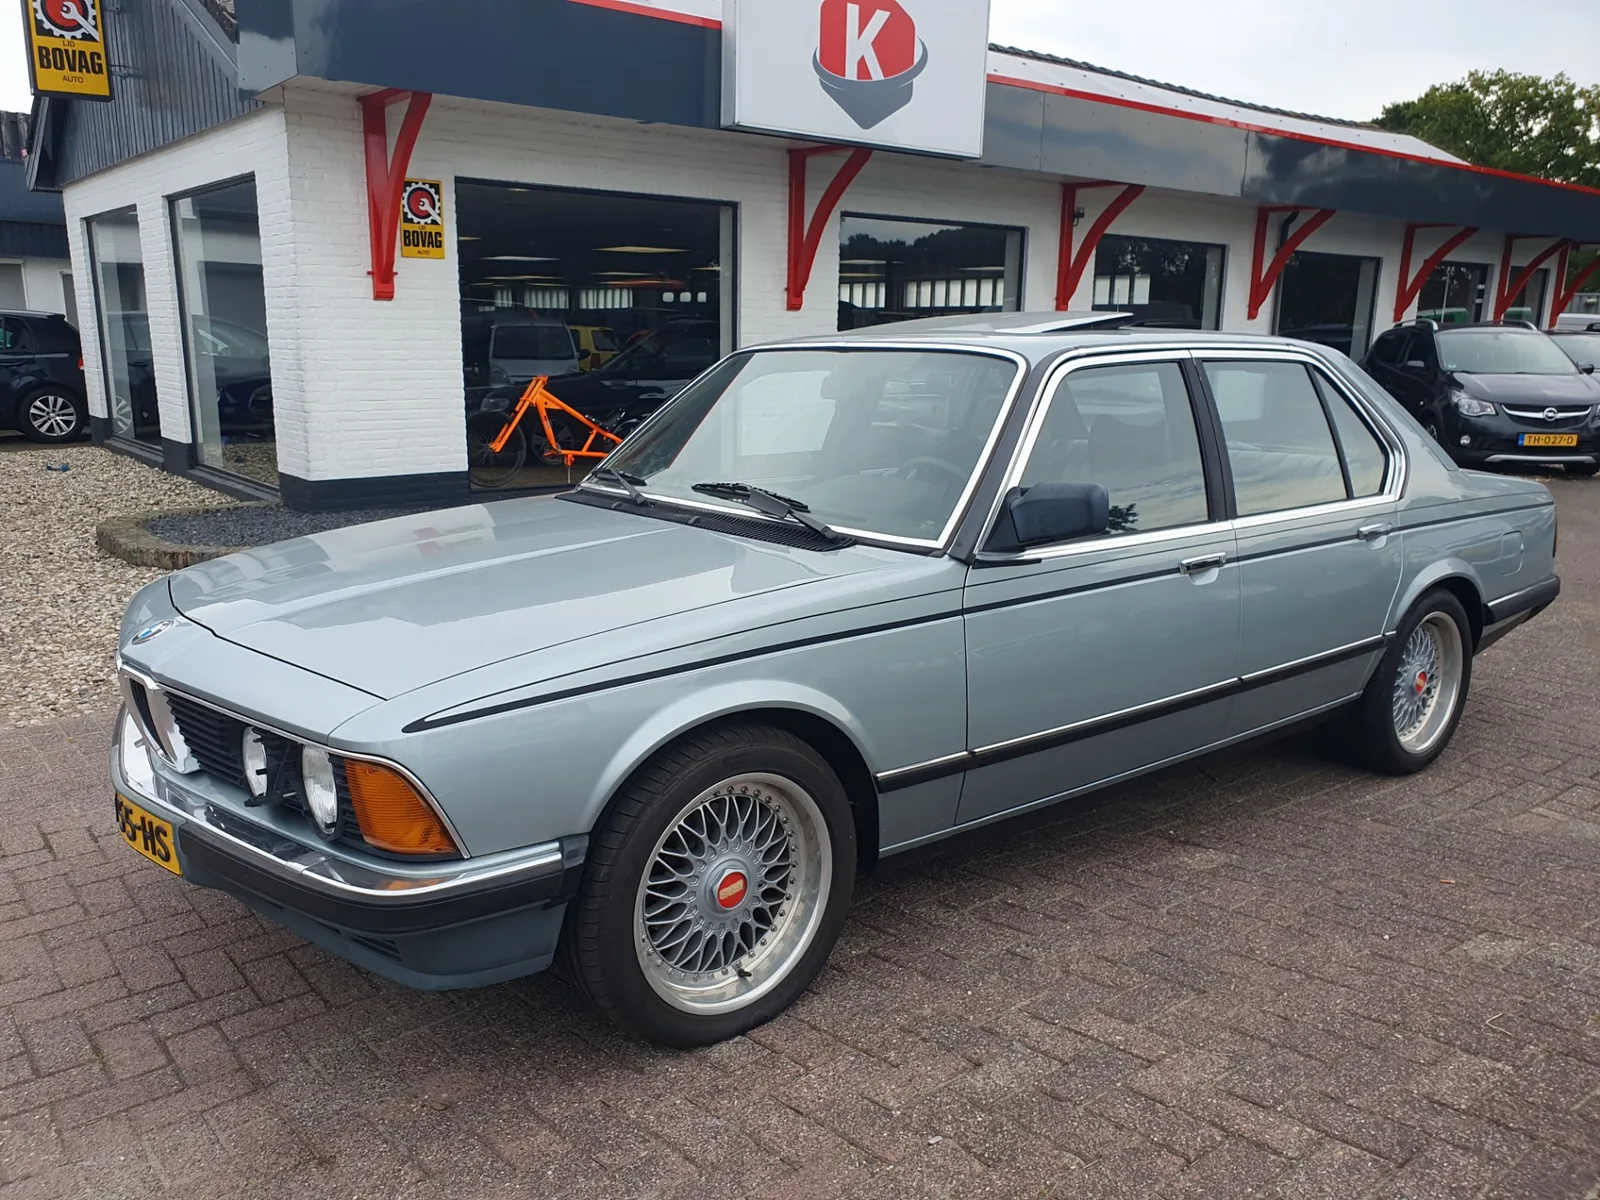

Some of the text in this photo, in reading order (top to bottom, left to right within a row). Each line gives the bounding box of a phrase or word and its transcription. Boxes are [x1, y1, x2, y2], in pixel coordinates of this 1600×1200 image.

[62, 40, 76, 48] LID
[845, 2, 891, 80] K
[37, 45, 104, 75] BOVAG
[62, 75, 84, 84] AUTO
[403, 229, 443, 249] BOVAG
